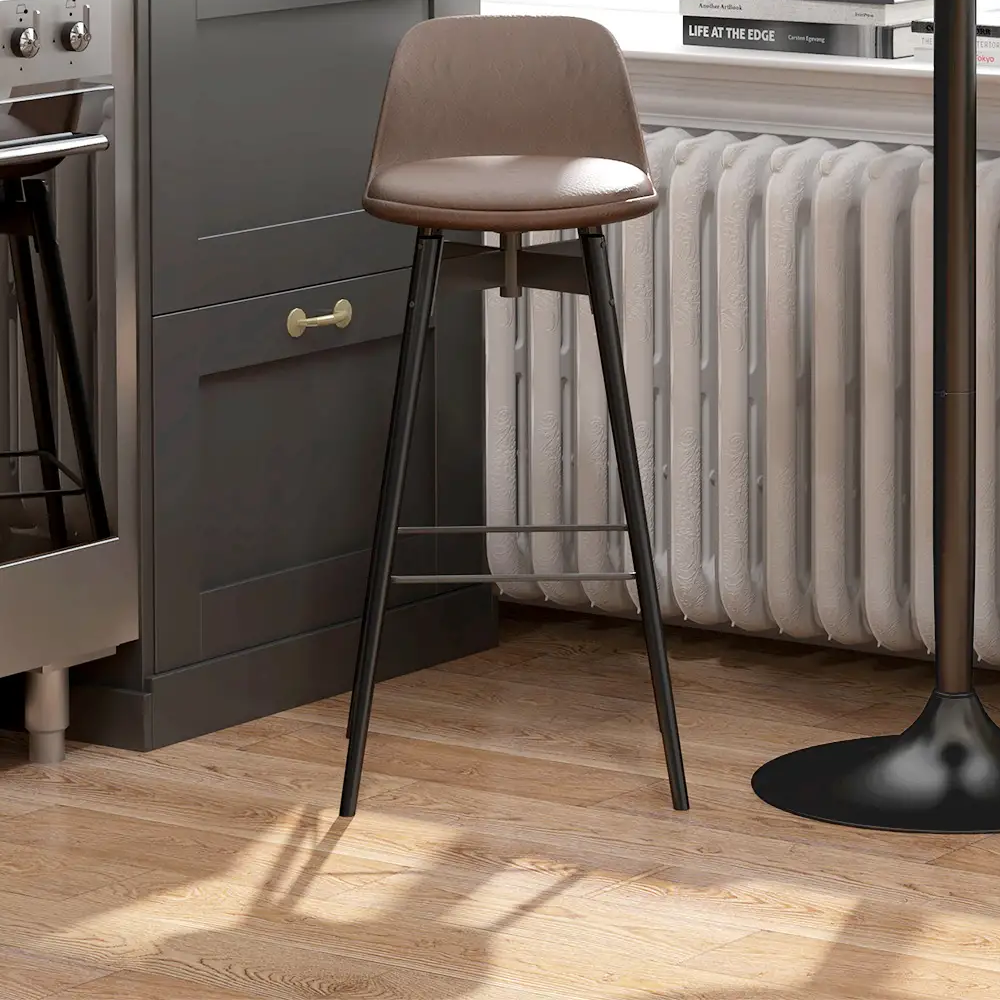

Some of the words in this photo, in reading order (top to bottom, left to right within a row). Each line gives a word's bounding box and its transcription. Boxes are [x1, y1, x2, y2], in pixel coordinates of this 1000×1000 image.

[688, 24, 709, 37] LIFE
[710, 26, 724, 39] AT
[725, 27, 746, 40] THE
[747, 28, 776, 42] EDGE
[921, 37, 932, 45] THE
[976, 41, 1000, 49] TERIOR
